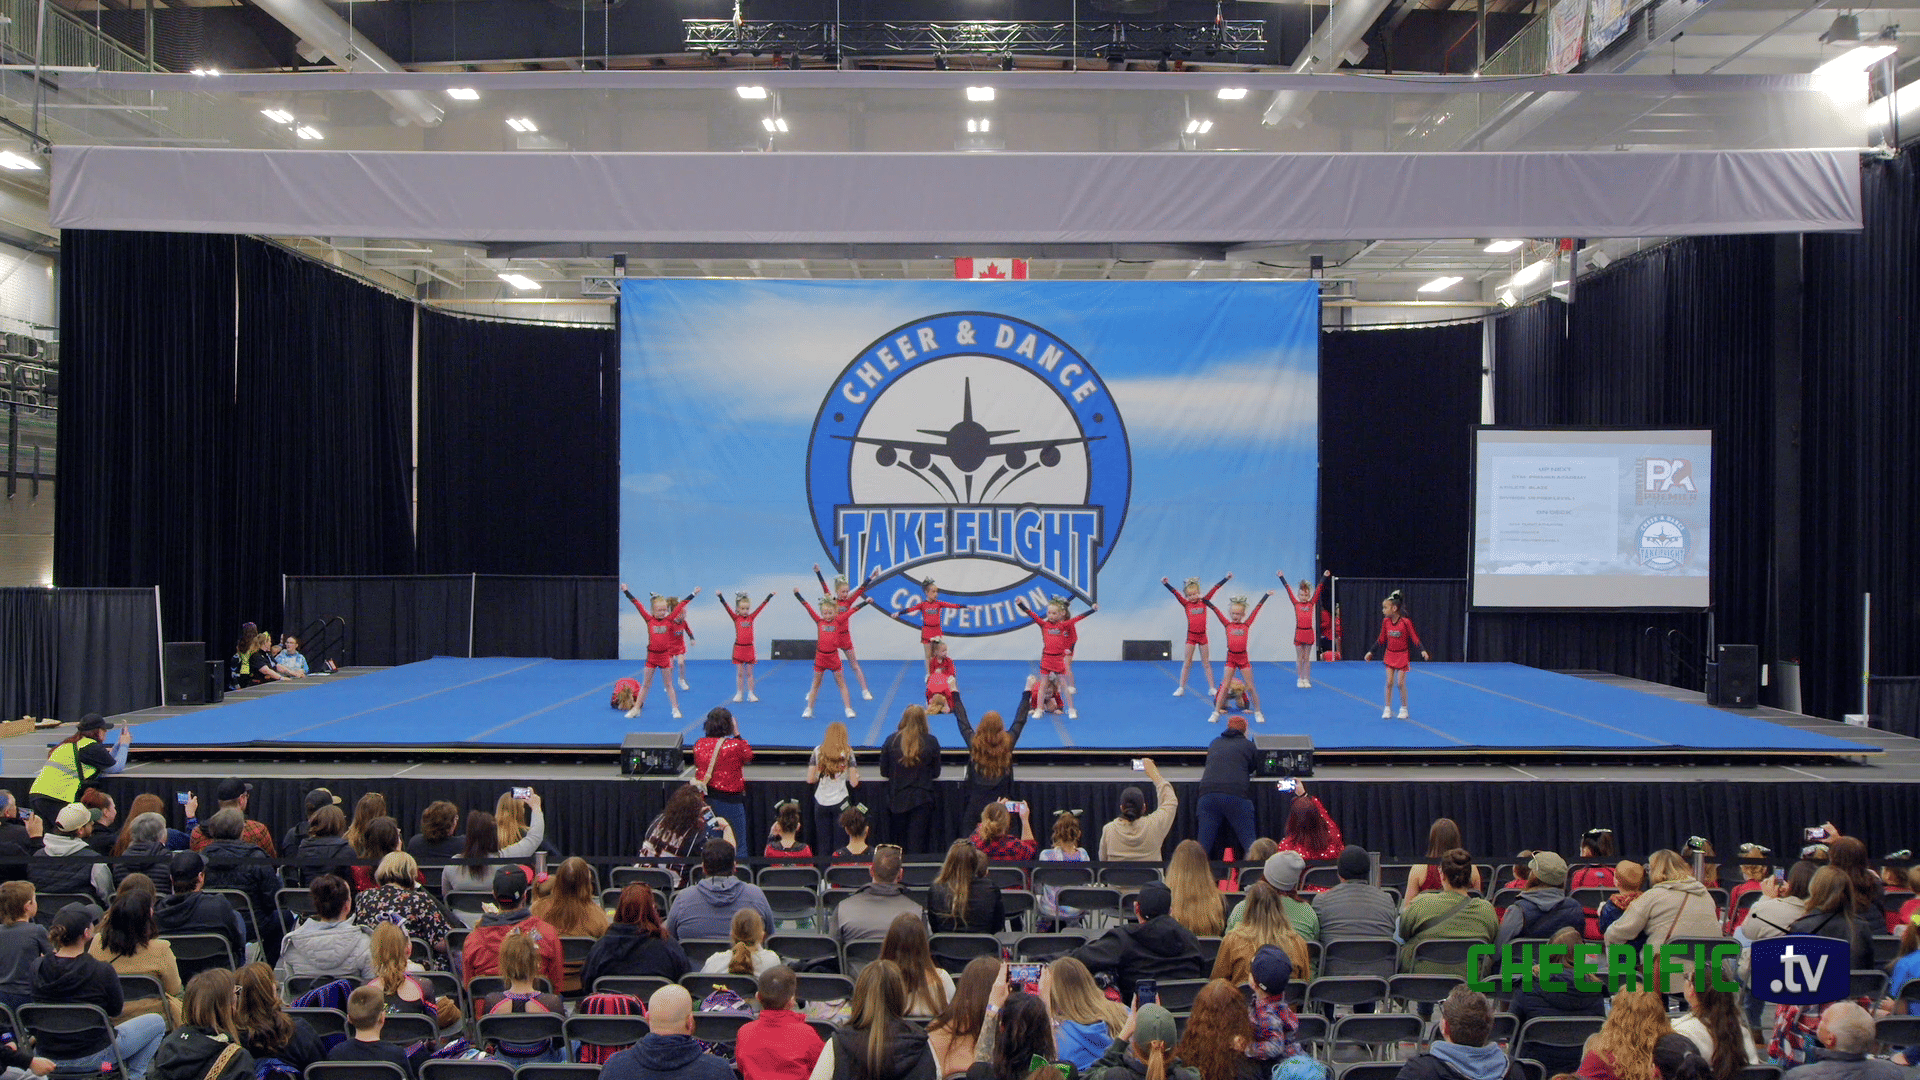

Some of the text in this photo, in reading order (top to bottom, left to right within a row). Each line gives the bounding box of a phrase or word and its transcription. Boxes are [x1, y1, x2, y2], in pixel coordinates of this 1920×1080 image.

[841, 316, 1099, 405] CHEER & DANCE
[840, 507, 1098, 600] TAKE FLIGHT
[891, 586, 1050, 628] COPETITION
